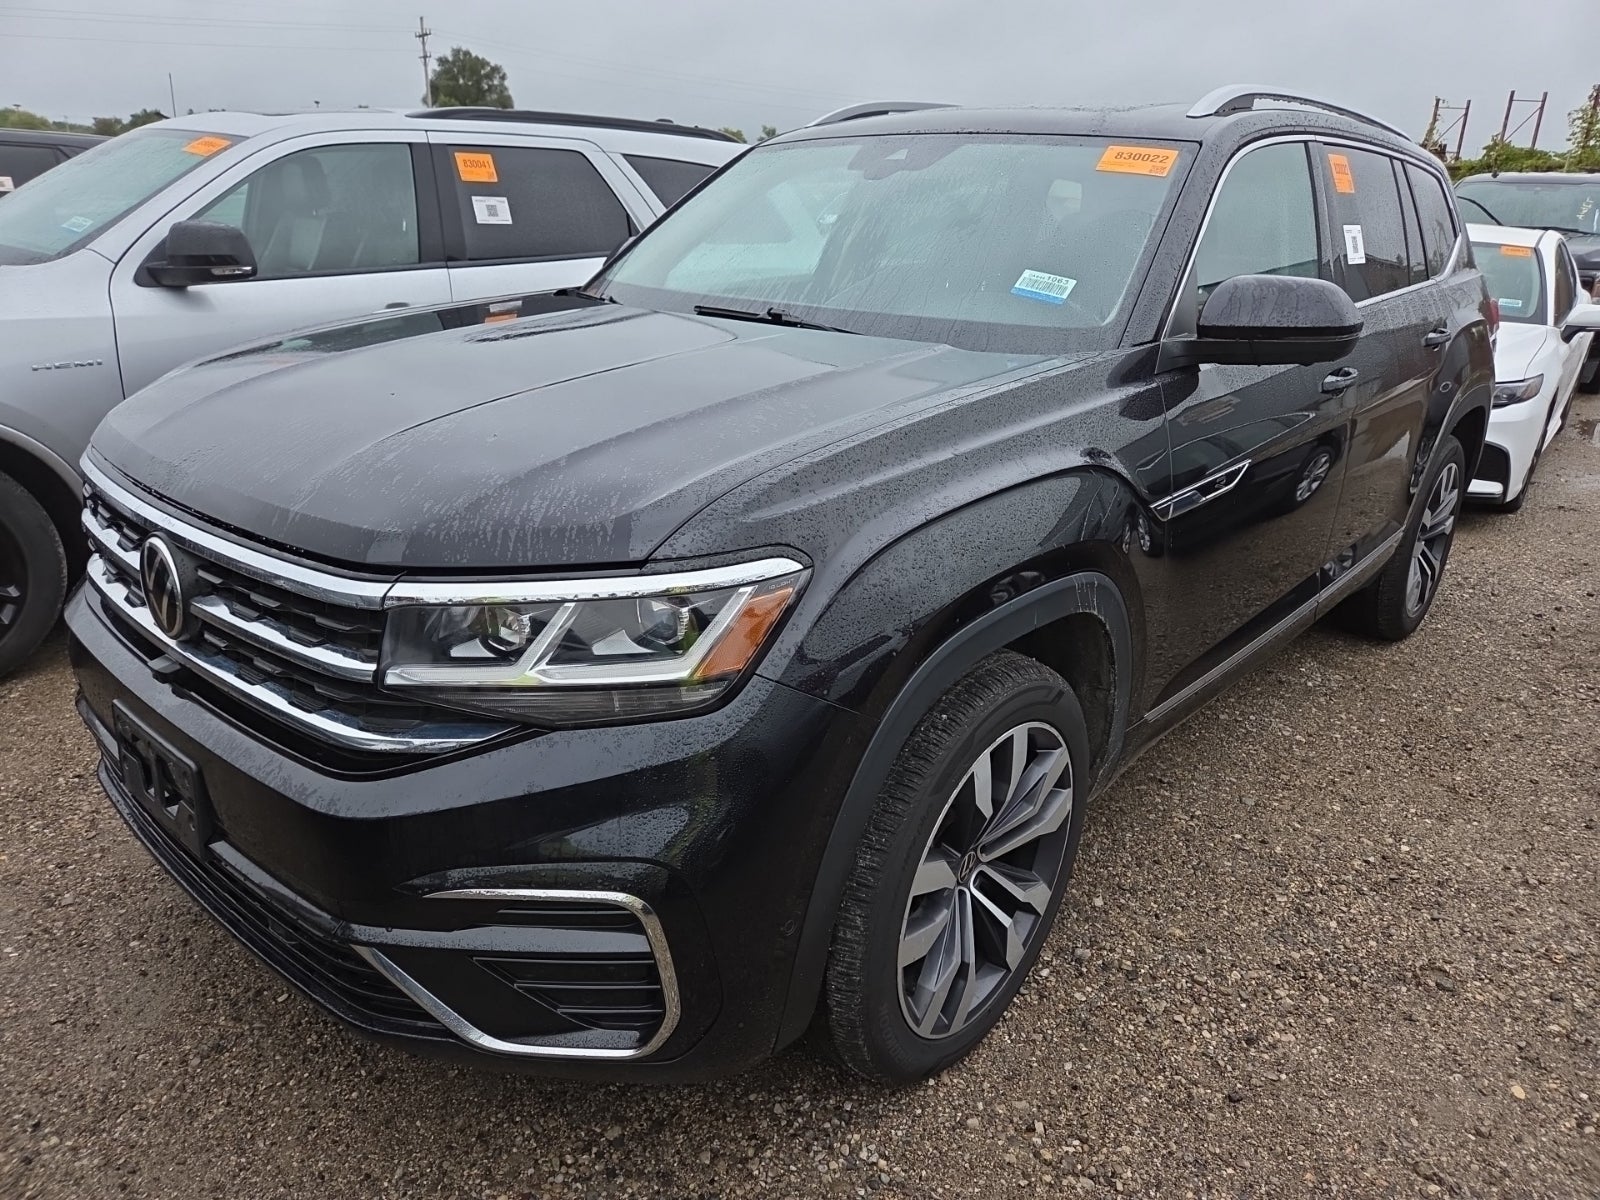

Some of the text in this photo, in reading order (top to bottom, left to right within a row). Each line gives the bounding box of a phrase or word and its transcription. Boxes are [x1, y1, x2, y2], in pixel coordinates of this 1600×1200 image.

[1114, 151, 1169, 164] 830022
[462, 159, 492, 169] 830041
[31, 359, 103, 371] HEMI
